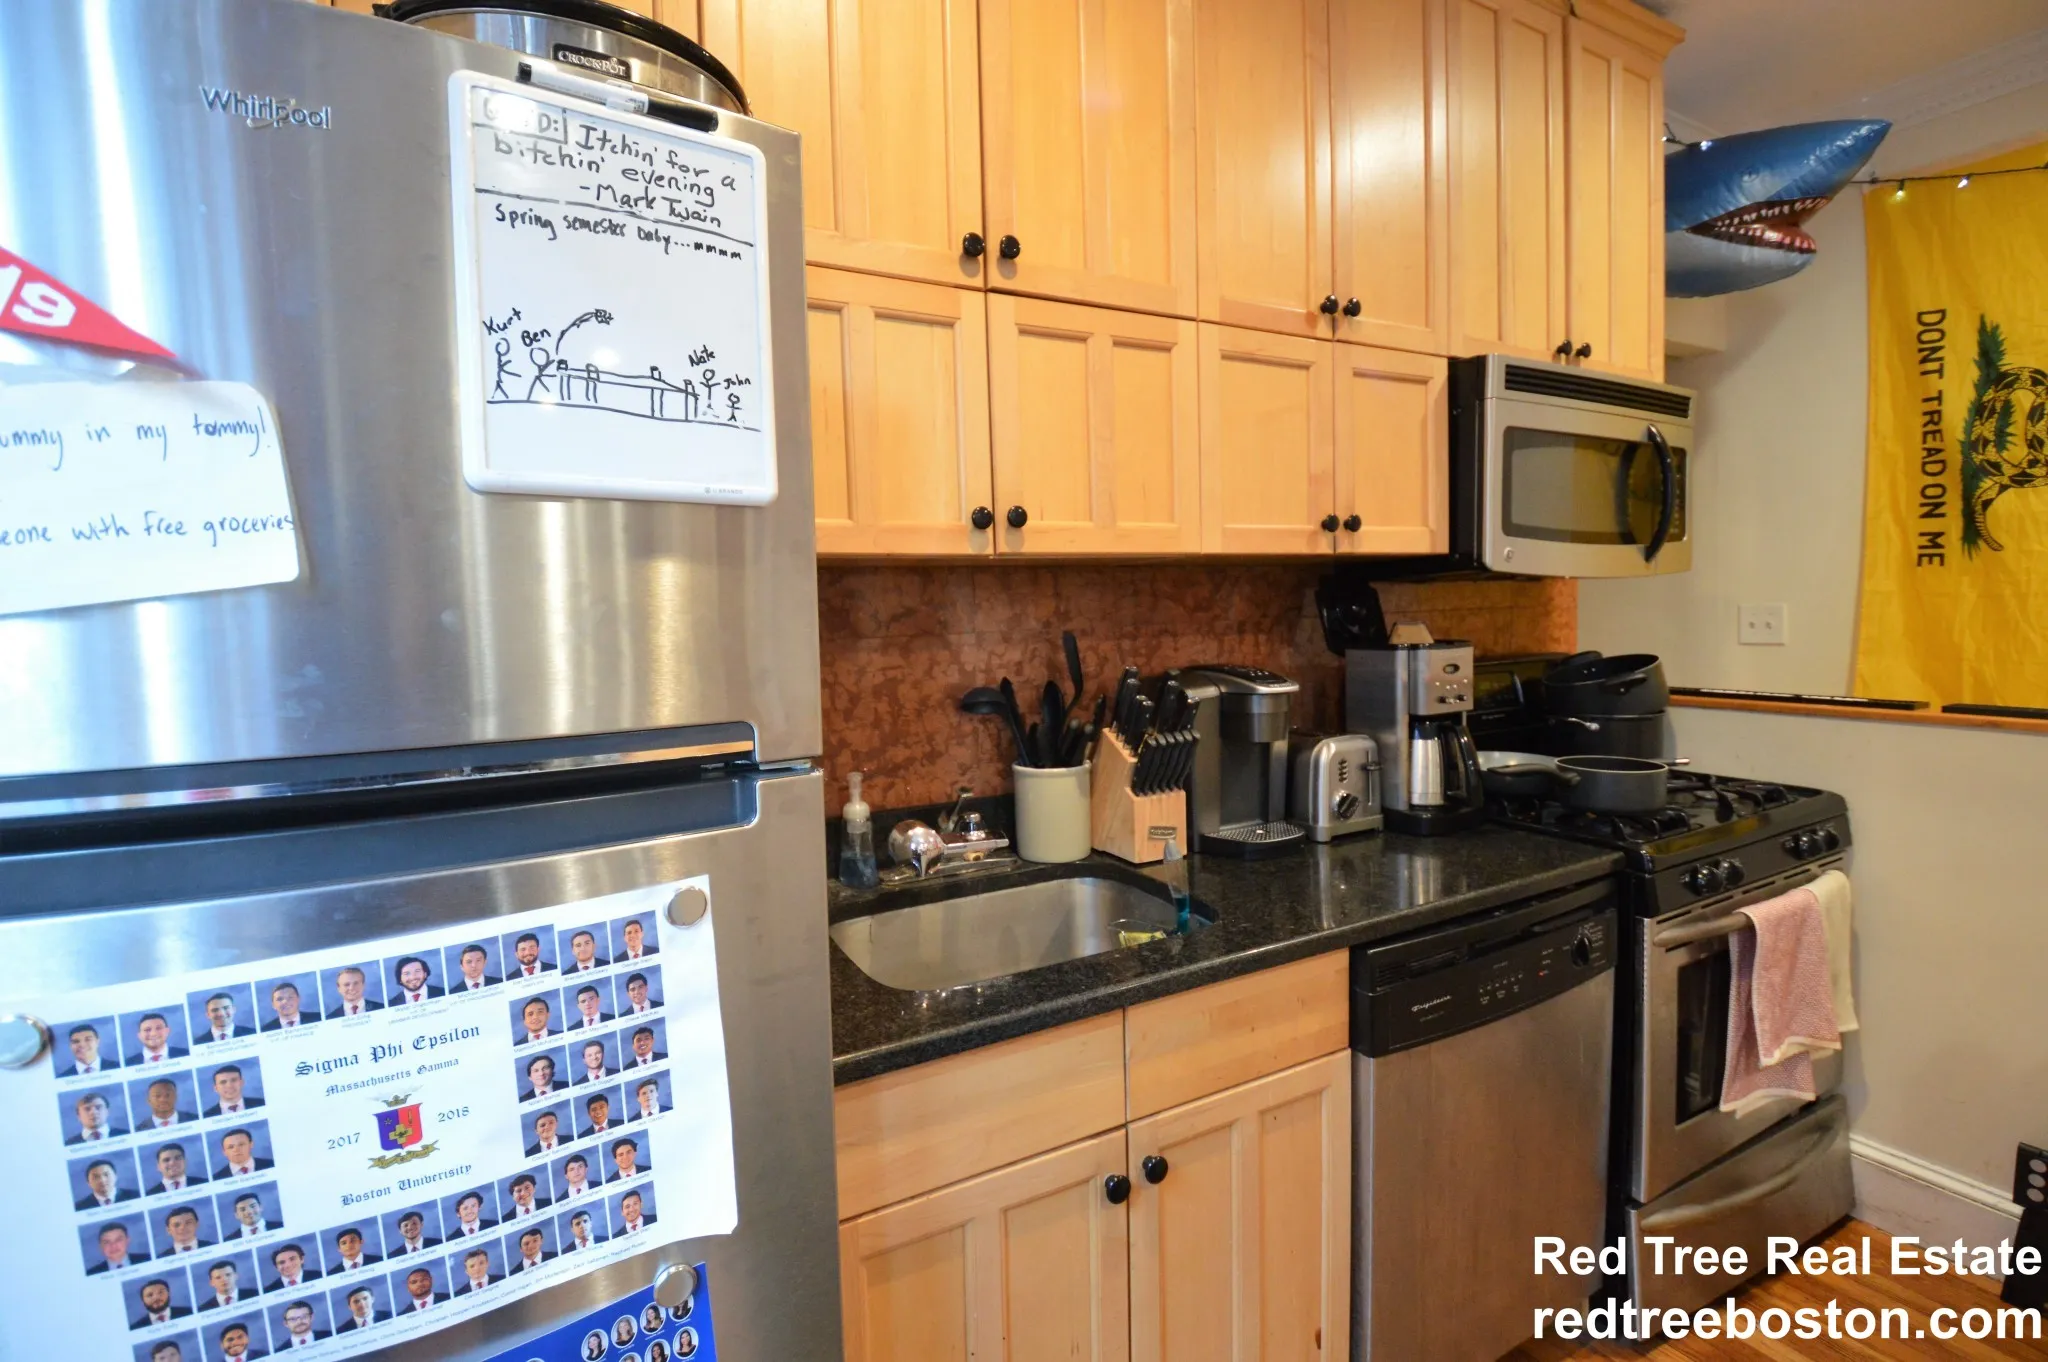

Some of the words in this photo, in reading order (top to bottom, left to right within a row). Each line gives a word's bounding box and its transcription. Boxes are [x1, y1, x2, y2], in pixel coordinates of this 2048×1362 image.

[199, 85, 332, 129] Whirlpool
[494, 133, 606, 174] bitchin'
[621, 166, 716, 208] evening
[575, 123, 659, 168] Itchin'
[666, 150, 710, 178] for
[721, 175, 736, 191] a
[495, 202, 558, 241] Spring
[563, 212, 627, 238] semester
[661, 196, 722, 229] Twain
[482, 307, 522, 336] Kurt
[521, 328, 552, 347] Ben
[1916, 309, 1947, 379] DONT
[688, 344, 716, 367] Nate
[723, 373, 751, 390] John
[86, 424, 111, 443] in
[137, 425, 168, 461] my
[1920, 390, 1947, 477] TREAD
[1918, 483, 1947, 519] ON
[72, 513, 130, 541] with
[203, 514, 295, 547] groceries
[1917, 532, 1946, 567] ME
[295, 1054, 359, 1077] Sigma
[370, 1040, 404, 1063] Phi
[412, 1026, 480, 1050] Epsilon
[325, 1069, 412, 1097] Massachusetts
[417, 1058, 459, 1075] Gamma
[328, 1132, 361, 1150] 2017
[438, 1106, 470, 1123] 2018
[340, 1185, 392, 1206] Boston
